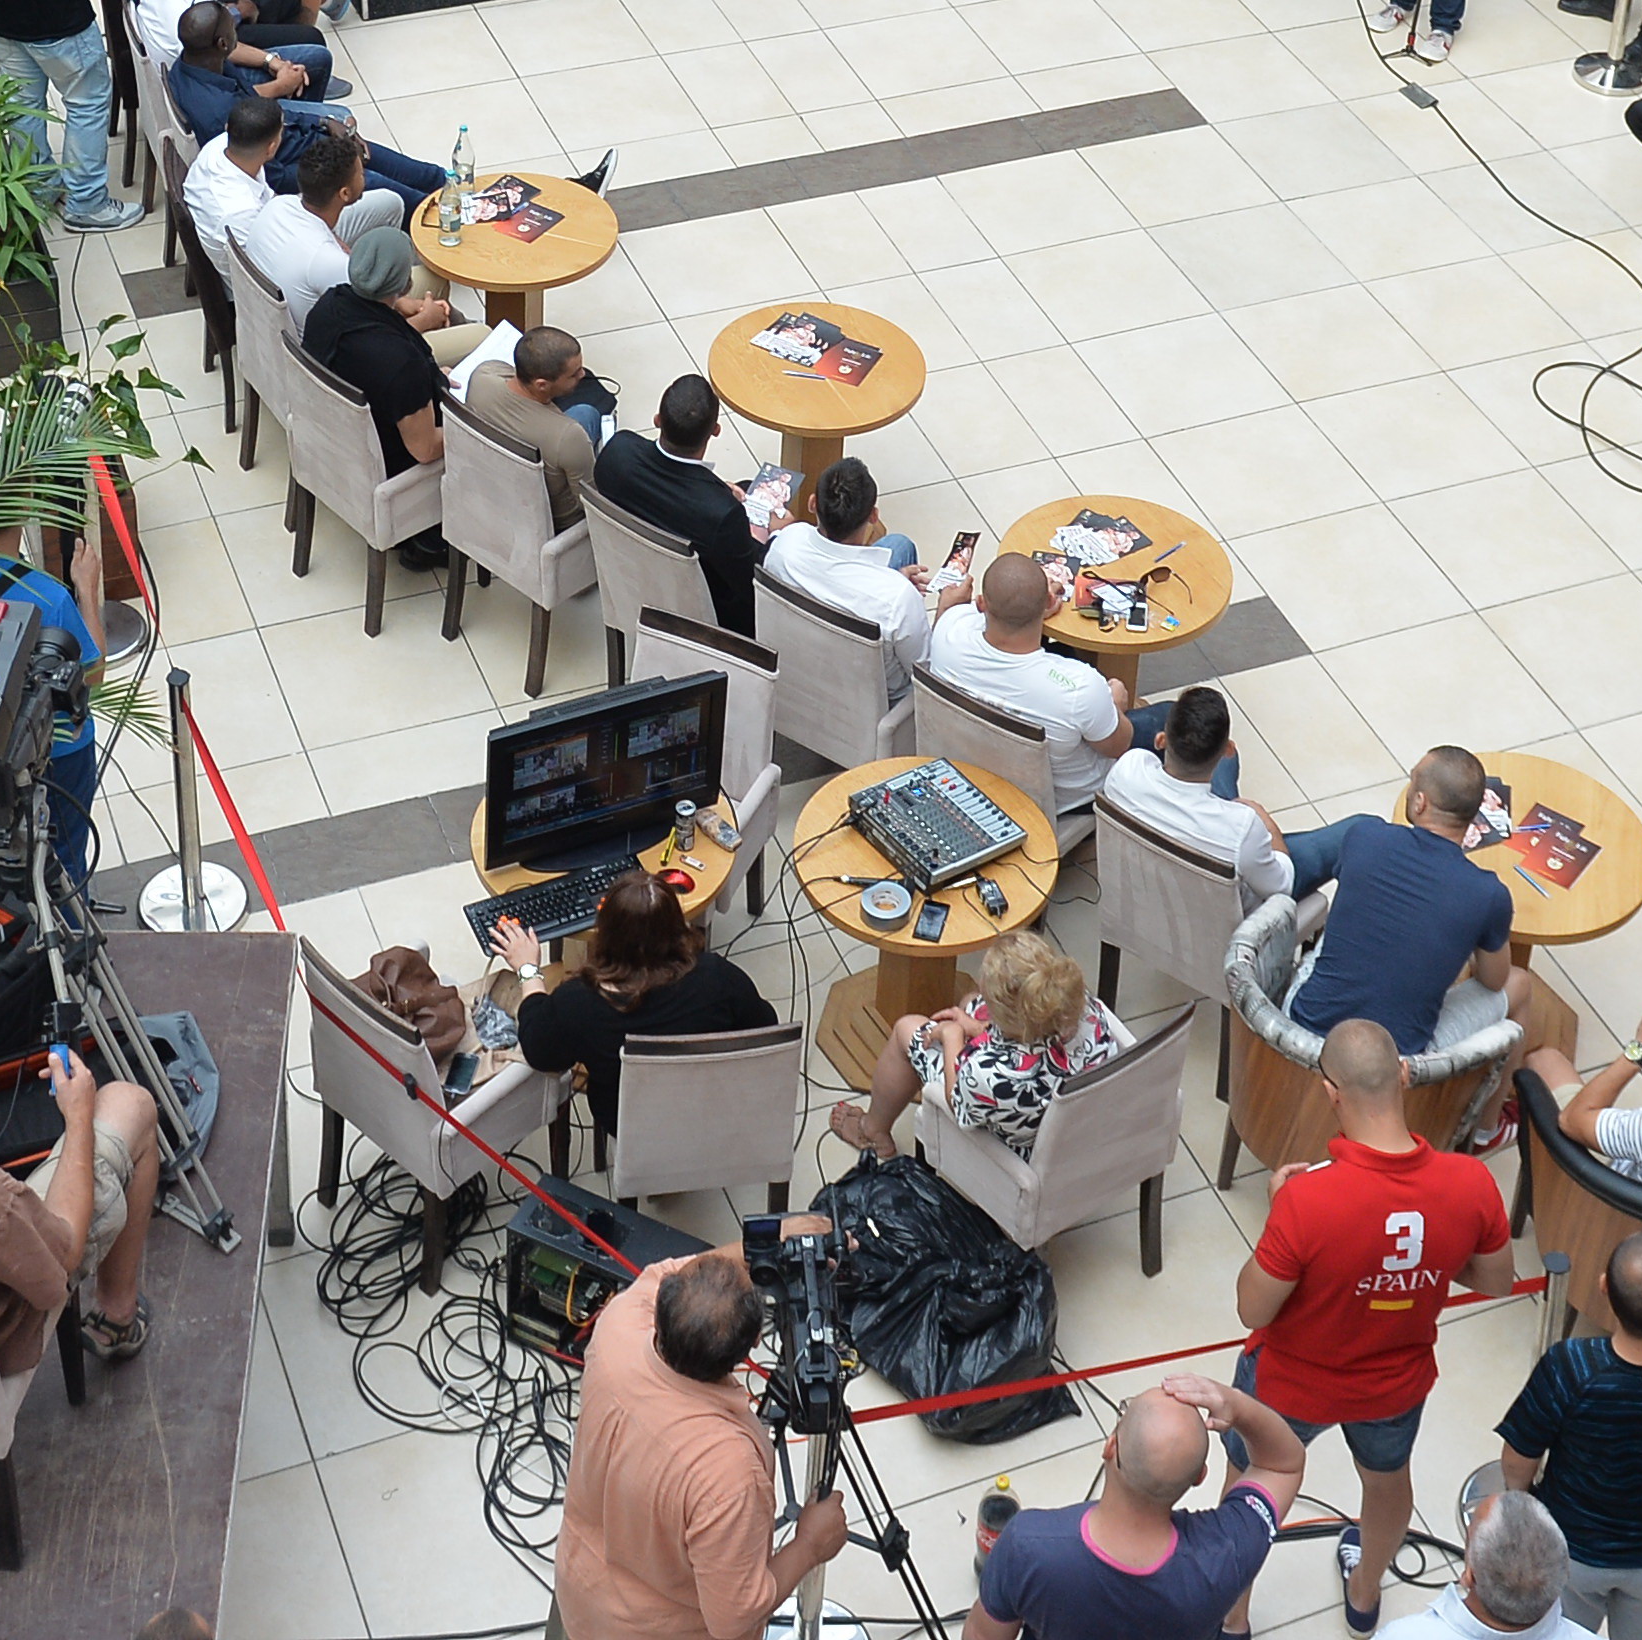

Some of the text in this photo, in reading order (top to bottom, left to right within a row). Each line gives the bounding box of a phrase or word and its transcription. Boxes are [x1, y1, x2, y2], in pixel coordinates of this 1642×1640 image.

[1048, 668, 1077, 689] BOSS
[1383, 1210, 1424, 1272] 3
[1355, 1267, 1442, 1297] SPAIN
